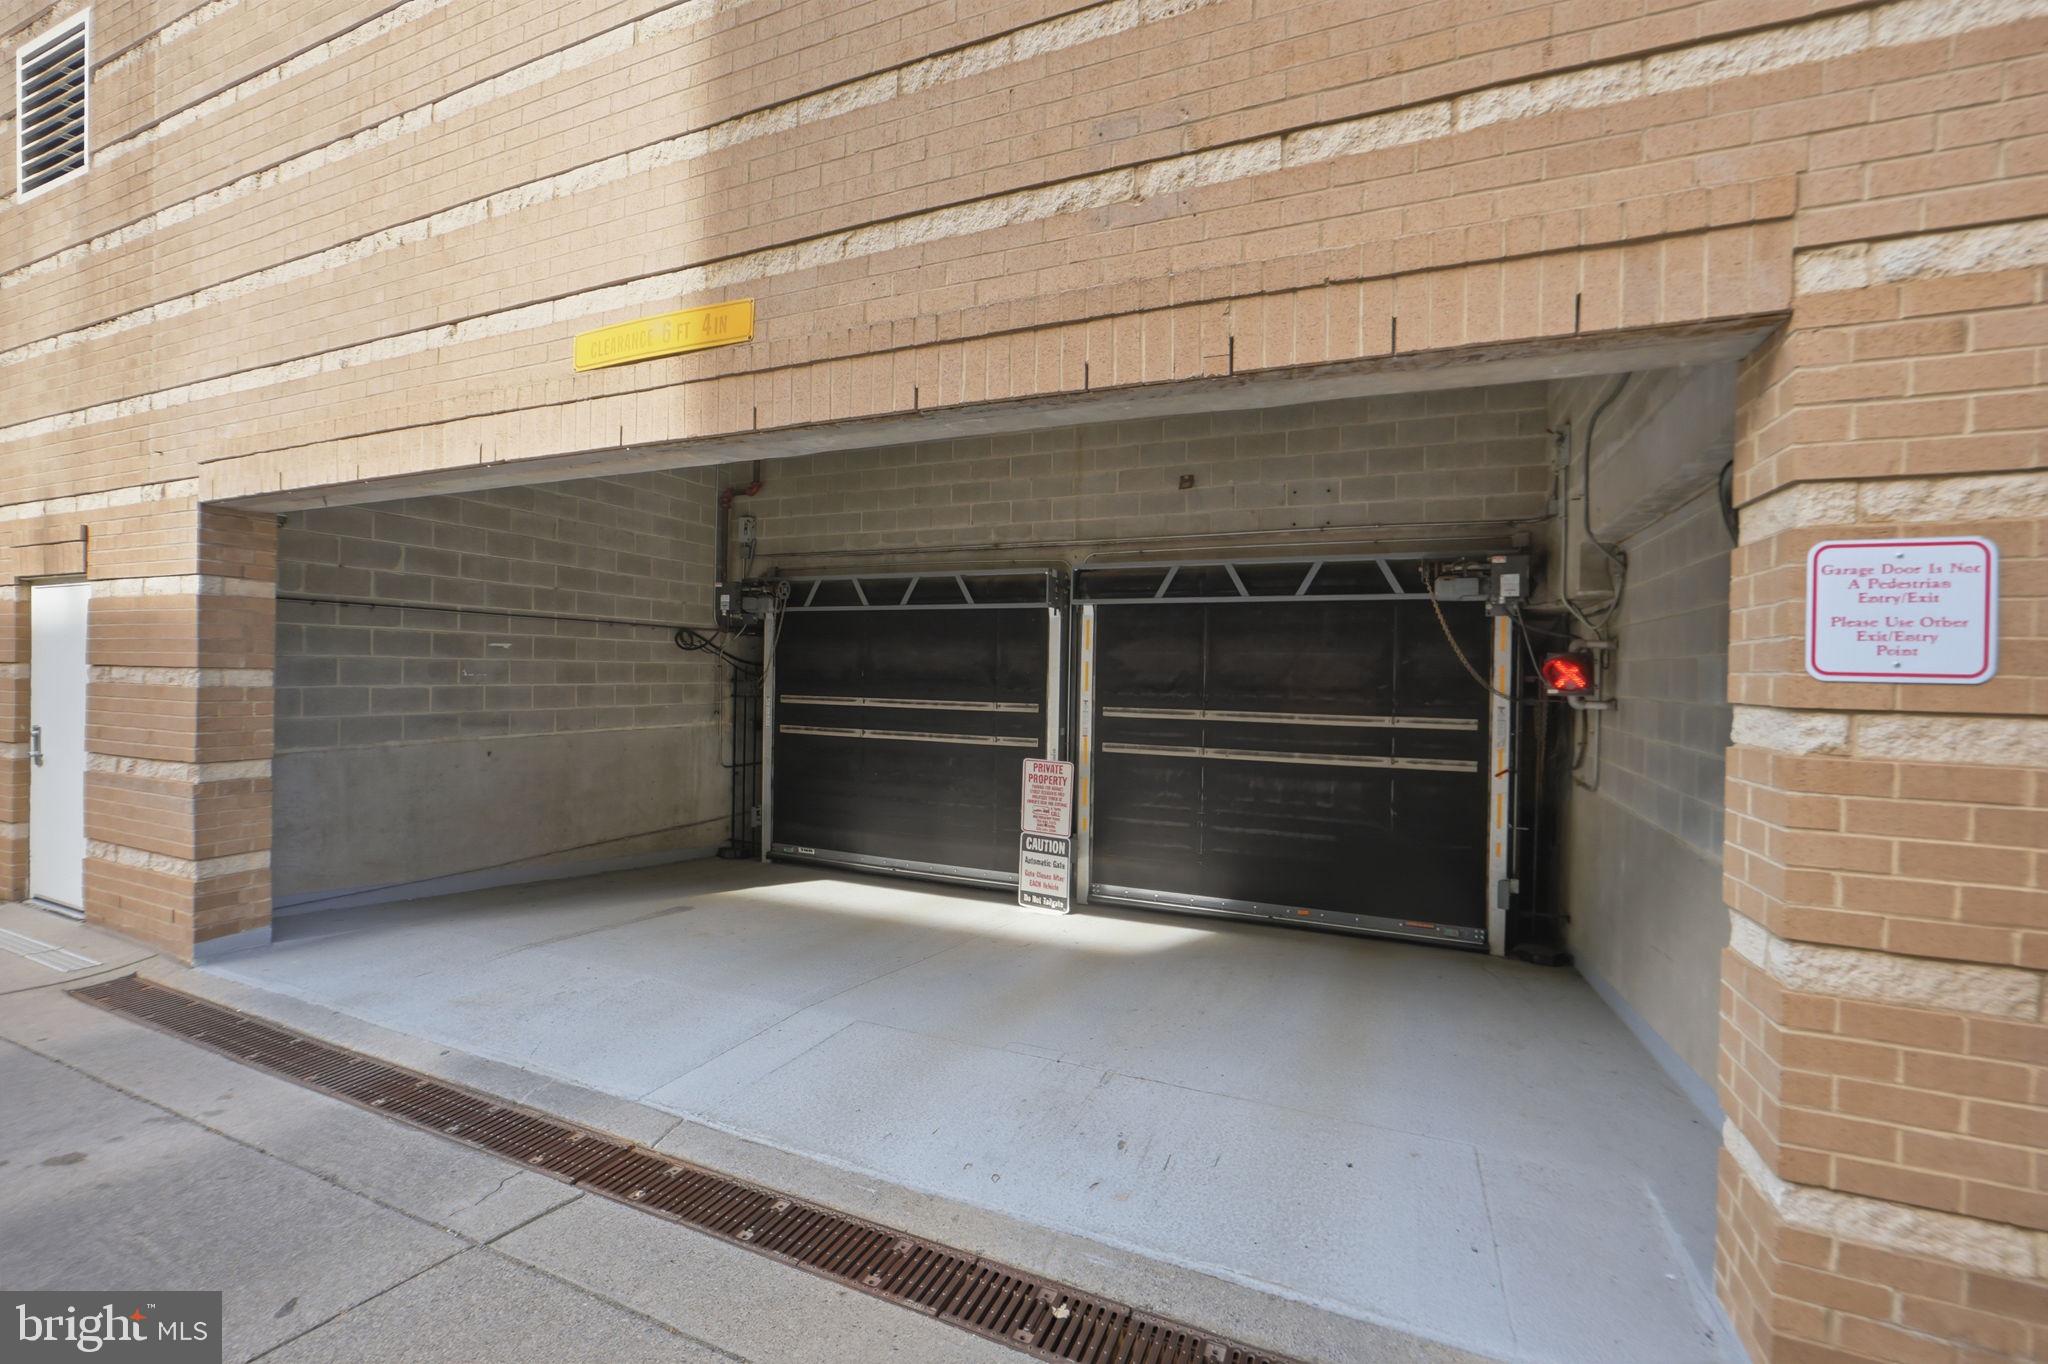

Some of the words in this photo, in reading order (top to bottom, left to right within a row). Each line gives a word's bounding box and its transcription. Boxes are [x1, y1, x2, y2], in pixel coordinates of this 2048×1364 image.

[590, 328, 653, 359] CLEARANCE
[661, 319, 673, 344] 6
[676, 321, 692, 342] FT
[1821, 564, 1875, 577] Garage
[1881, 563, 1923, 575] Door
[1928, 563, 1943, 574] Is
[1950, 562, 1983, 574] Not
[1848, 578, 1860, 589] A
[1867, 577, 1953, 590] Pedestrian
[1857, 591, 1941, 605] Entry/Exit
[1830, 615, 1879, 628] Please
[1885, 615, 1914, 628] Use
[1919, 615, 1970, 628] Other
[1856, 630, 1940, 644] Exit/Entry
[1876, 644, 1919, 657] Point
[1033, 762, 1064, 775] PRIVATE
[1028, 773, 1068, 787] PROPERTY
[1025, 837, 1066, 855] CAUTION
[1024, 855, 1052, 868] Automatic
[1052, 860, 1066, 870] Gate
[1023, 893, 1032, 902] Do
[1032, 895, 1042, 904] Not
[1042, 896, 1064, 909] Tailgate
